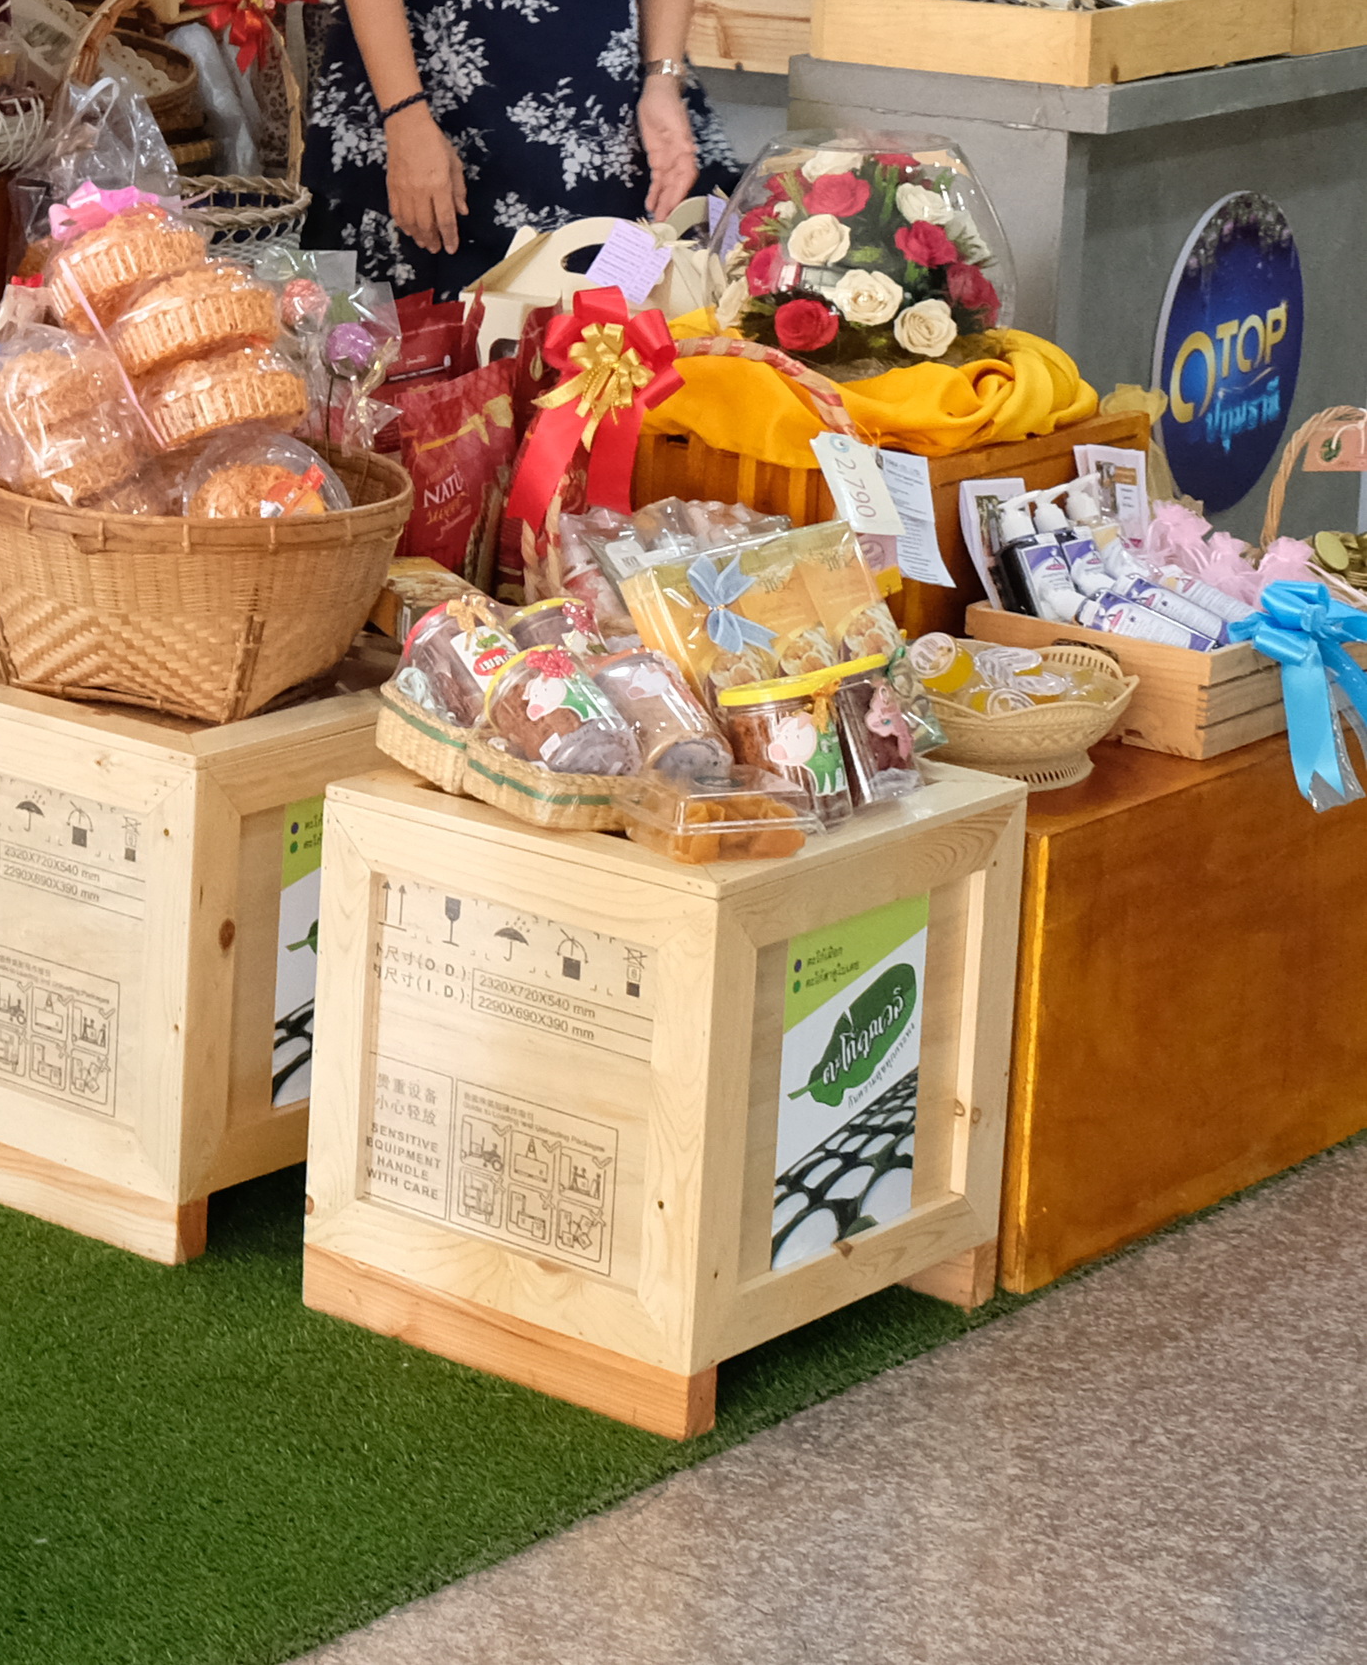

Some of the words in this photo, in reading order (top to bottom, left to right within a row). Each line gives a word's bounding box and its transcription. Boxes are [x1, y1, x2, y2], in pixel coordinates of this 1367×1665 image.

[1170, 306, 1287, 423] OTOP
[834, 457, 877, 518] 2,790
[478, 974, 570, 1011] 2320X720X540
[572, 1005, 596, 1019] mm
[477, 995, 568, 1032] 2290X690X390
[571, 1025, 595, 1040] mm
[366, 1136, 441, 1170] EQUIPMENT
[371, 1122, 439, 1153] SENSITIVE
[366, 1168, 399, 1186] WITH
[404, 1179, 439, 1200] CARE
[377, 1155, 429, 1182] HANDLE
